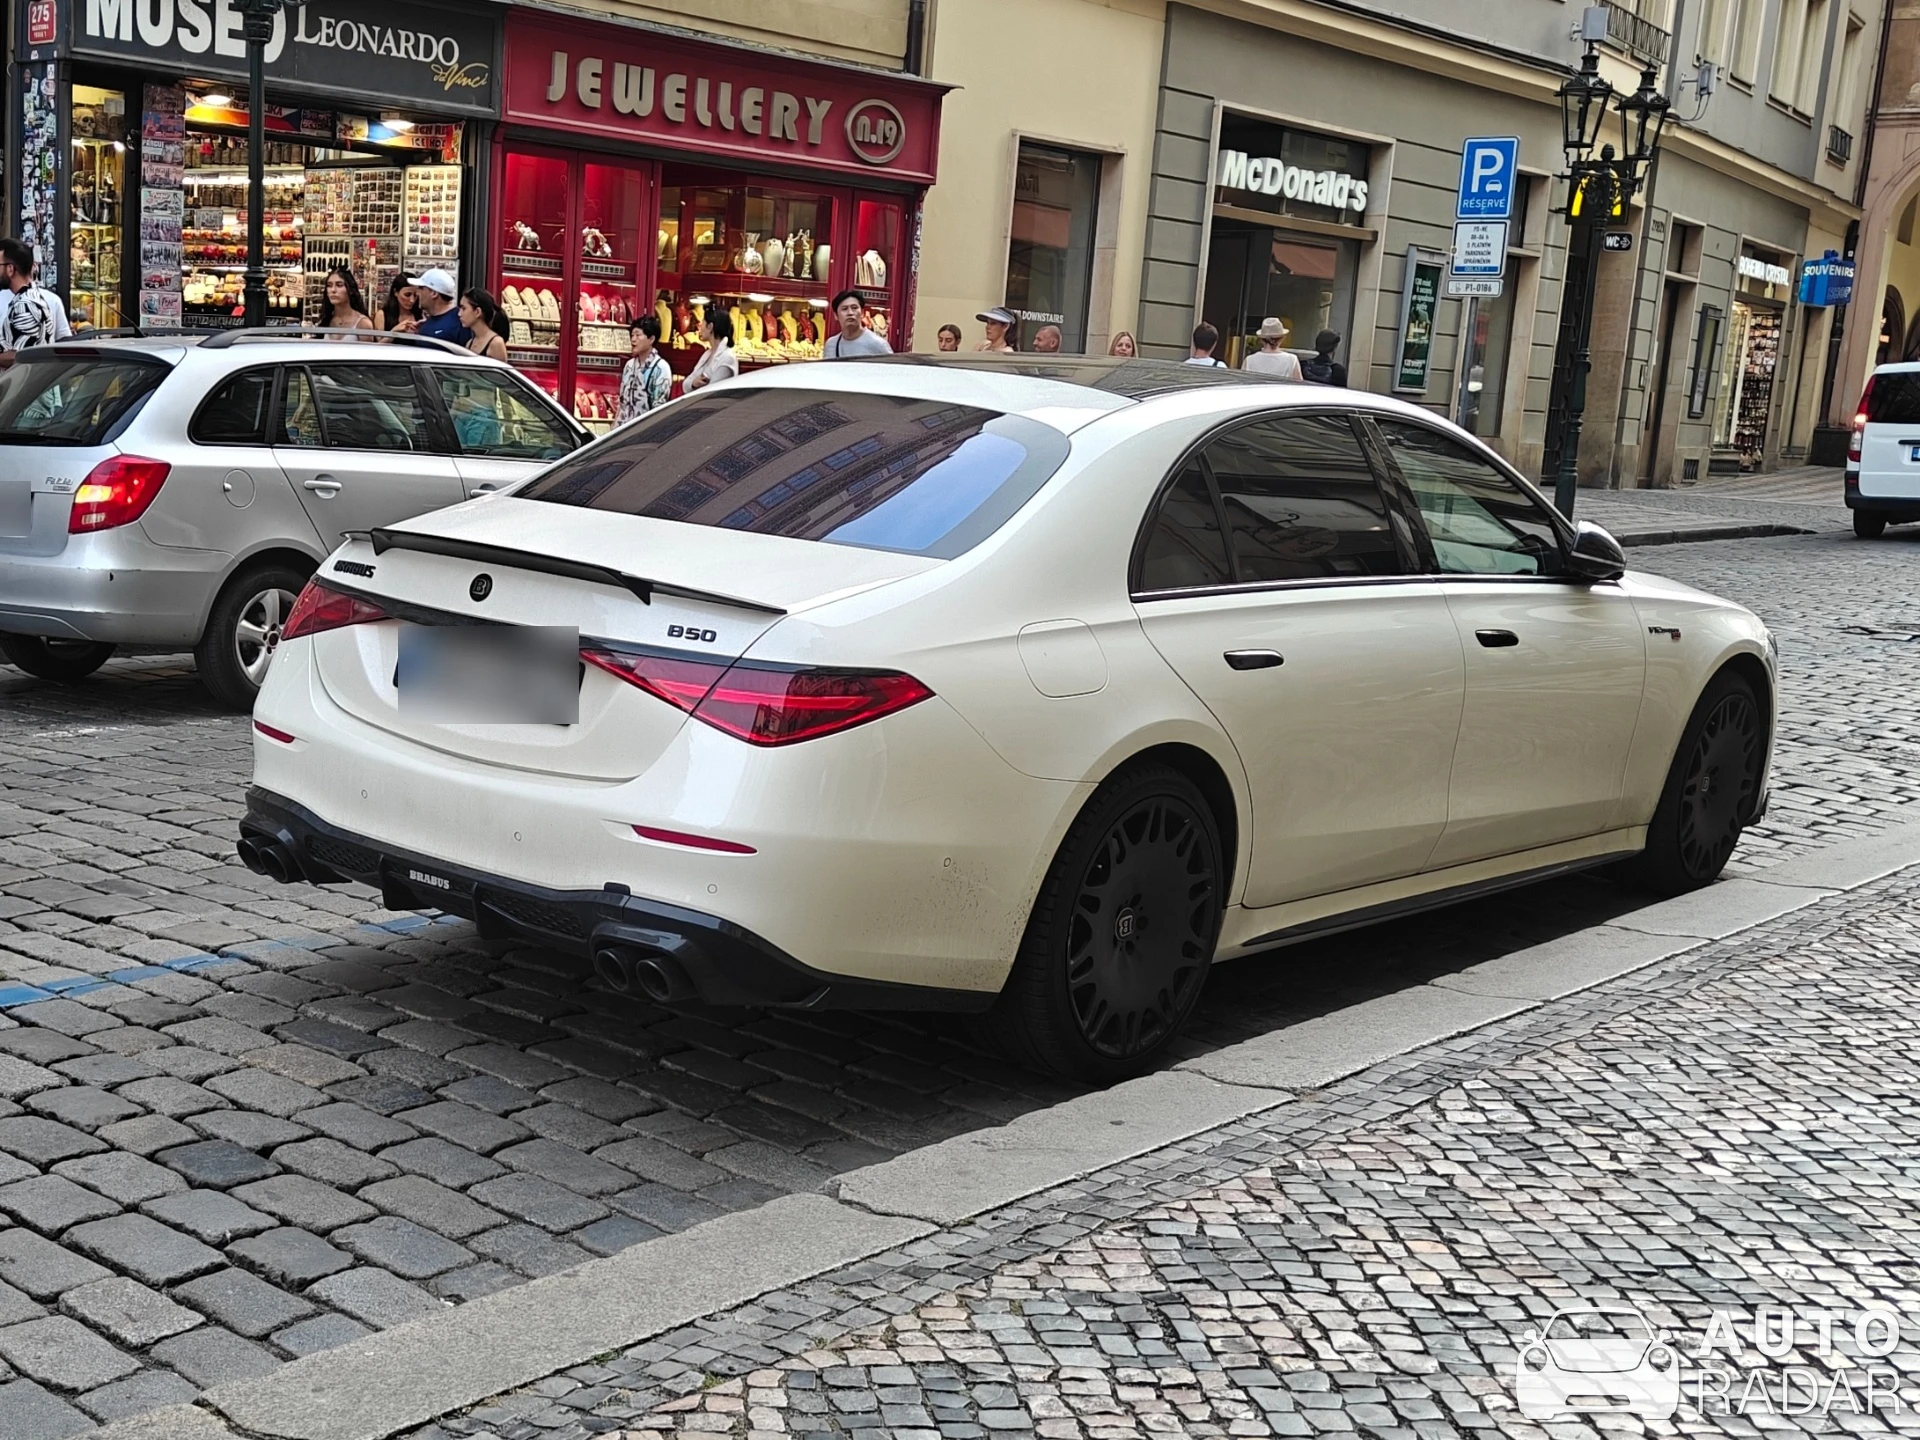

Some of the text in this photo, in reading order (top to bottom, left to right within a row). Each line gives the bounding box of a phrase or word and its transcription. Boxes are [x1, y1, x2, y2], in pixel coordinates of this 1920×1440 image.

[31, 4, 50, 24] 275
[293, 4, 460, 67] LEONARDO
[547, 50, 833, 145] JEWELLERY
[1219, 149, 1369, 212] McDonald's
[1470, 148, 1505, 193] P
[1462, 197, 1506, 209] RÉSERVÉ
[1605, 235, 1620, 248] WC
[1803, 264, 1854, 278] SOUVENIRS
[1022, 310, 1064, 324] DOWNSTAIRS
[409, 869, 450, 890] BRABUS
